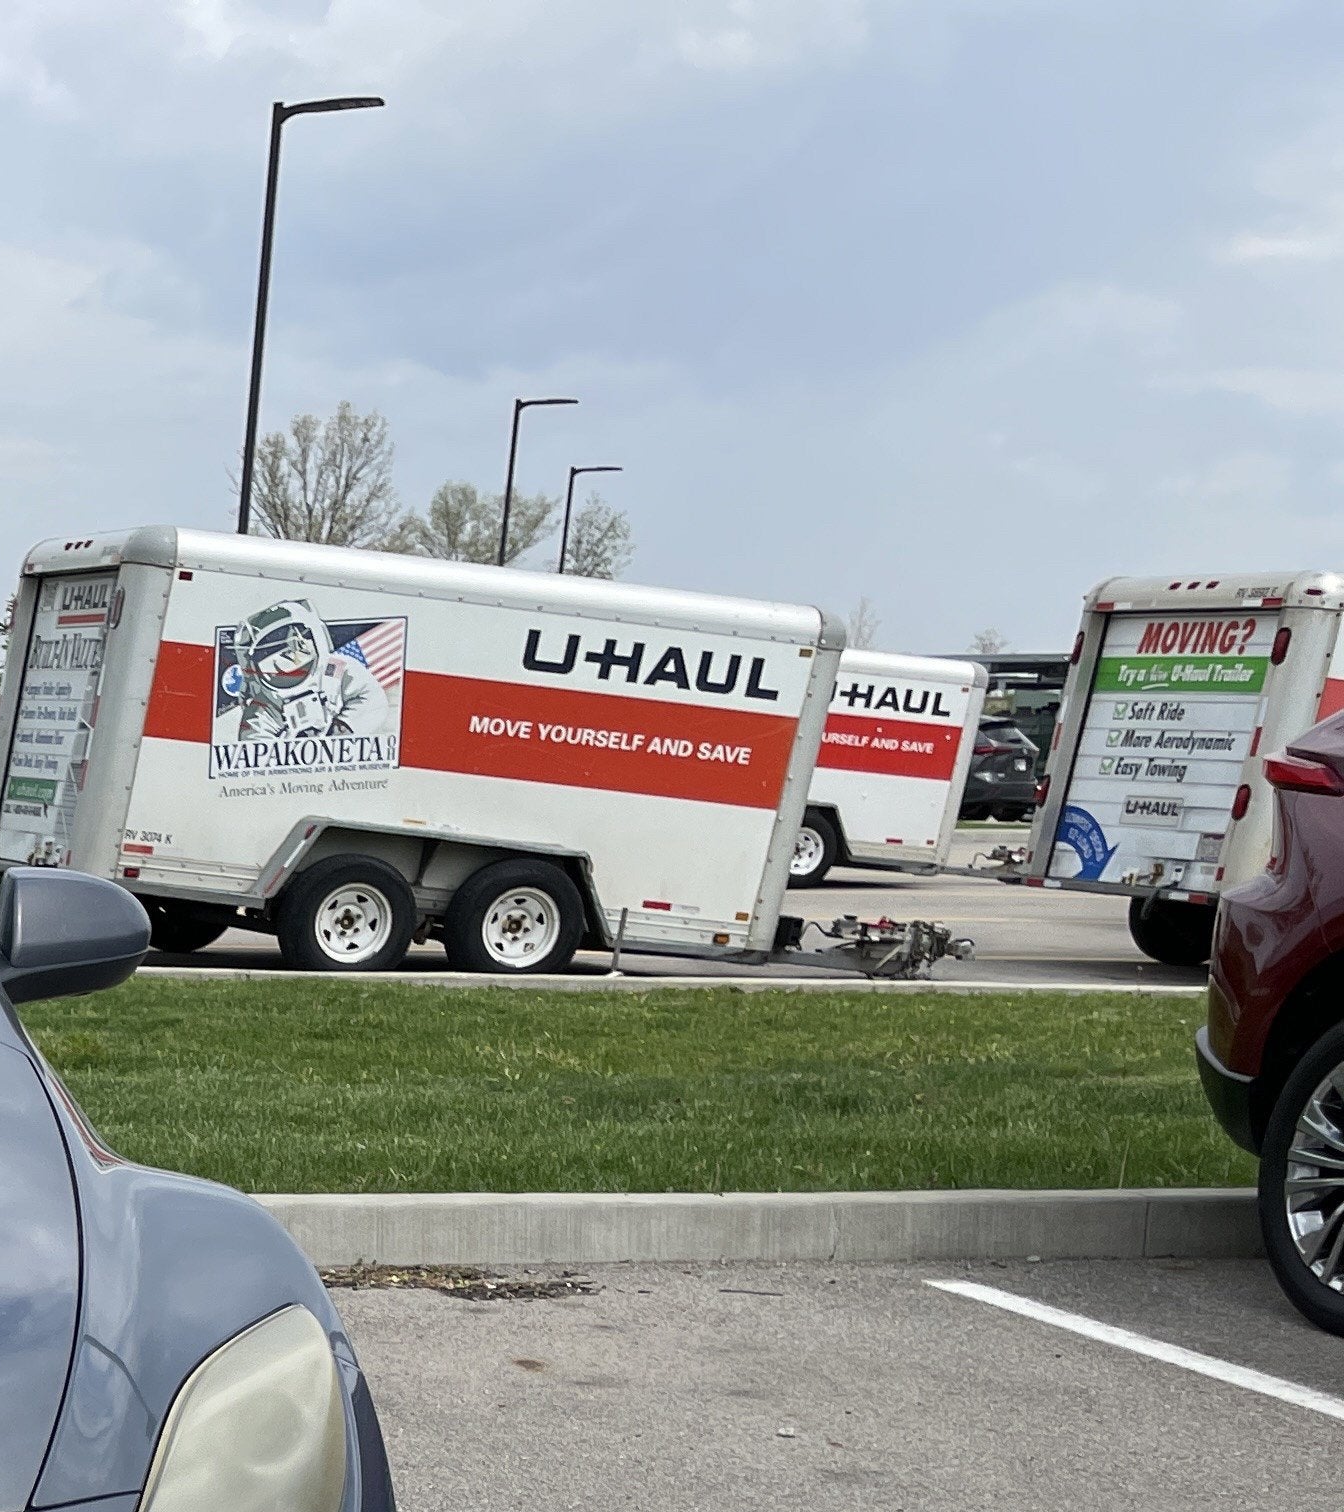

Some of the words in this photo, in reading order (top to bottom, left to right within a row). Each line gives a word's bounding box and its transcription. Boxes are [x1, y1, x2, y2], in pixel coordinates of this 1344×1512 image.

[1137, 617, 1257, 656] MOVING?
[523, 629, 779, 701] U-HAUL
[1118, 664, 1138, 687] Try
[1213, 663, 1255, 682] Trailer
[1128, 702, 1154, 721] Soft
[1157, 702, 1185, 721] Ride
[214, 736, 383, 770] WAPAKONETA
[469, 715, 533, 740] MOVE
[538, 723, 644, 752] YOURSELF
[647, 737, 693, 758] AND
[696, 741, 752, 766] SAVE
[821, 732, 869, 748] URSELF
[870, 737, 900, 751] AND
[901, 740, 934, 754] SAVE
[1120, 729, 1151, 748] More
[1155, 731, 1236, 755] Aerodynamic
[1114, 757, 1142, 781] Easy
[1145, 757, 1188, 783] Towing
[219, 782, 275, 798] America's
[280, 781, 324, 795] Moving
[328, 779, 387, 792] Adventure
[1125, 800, 1179, 817] U-HAUL
